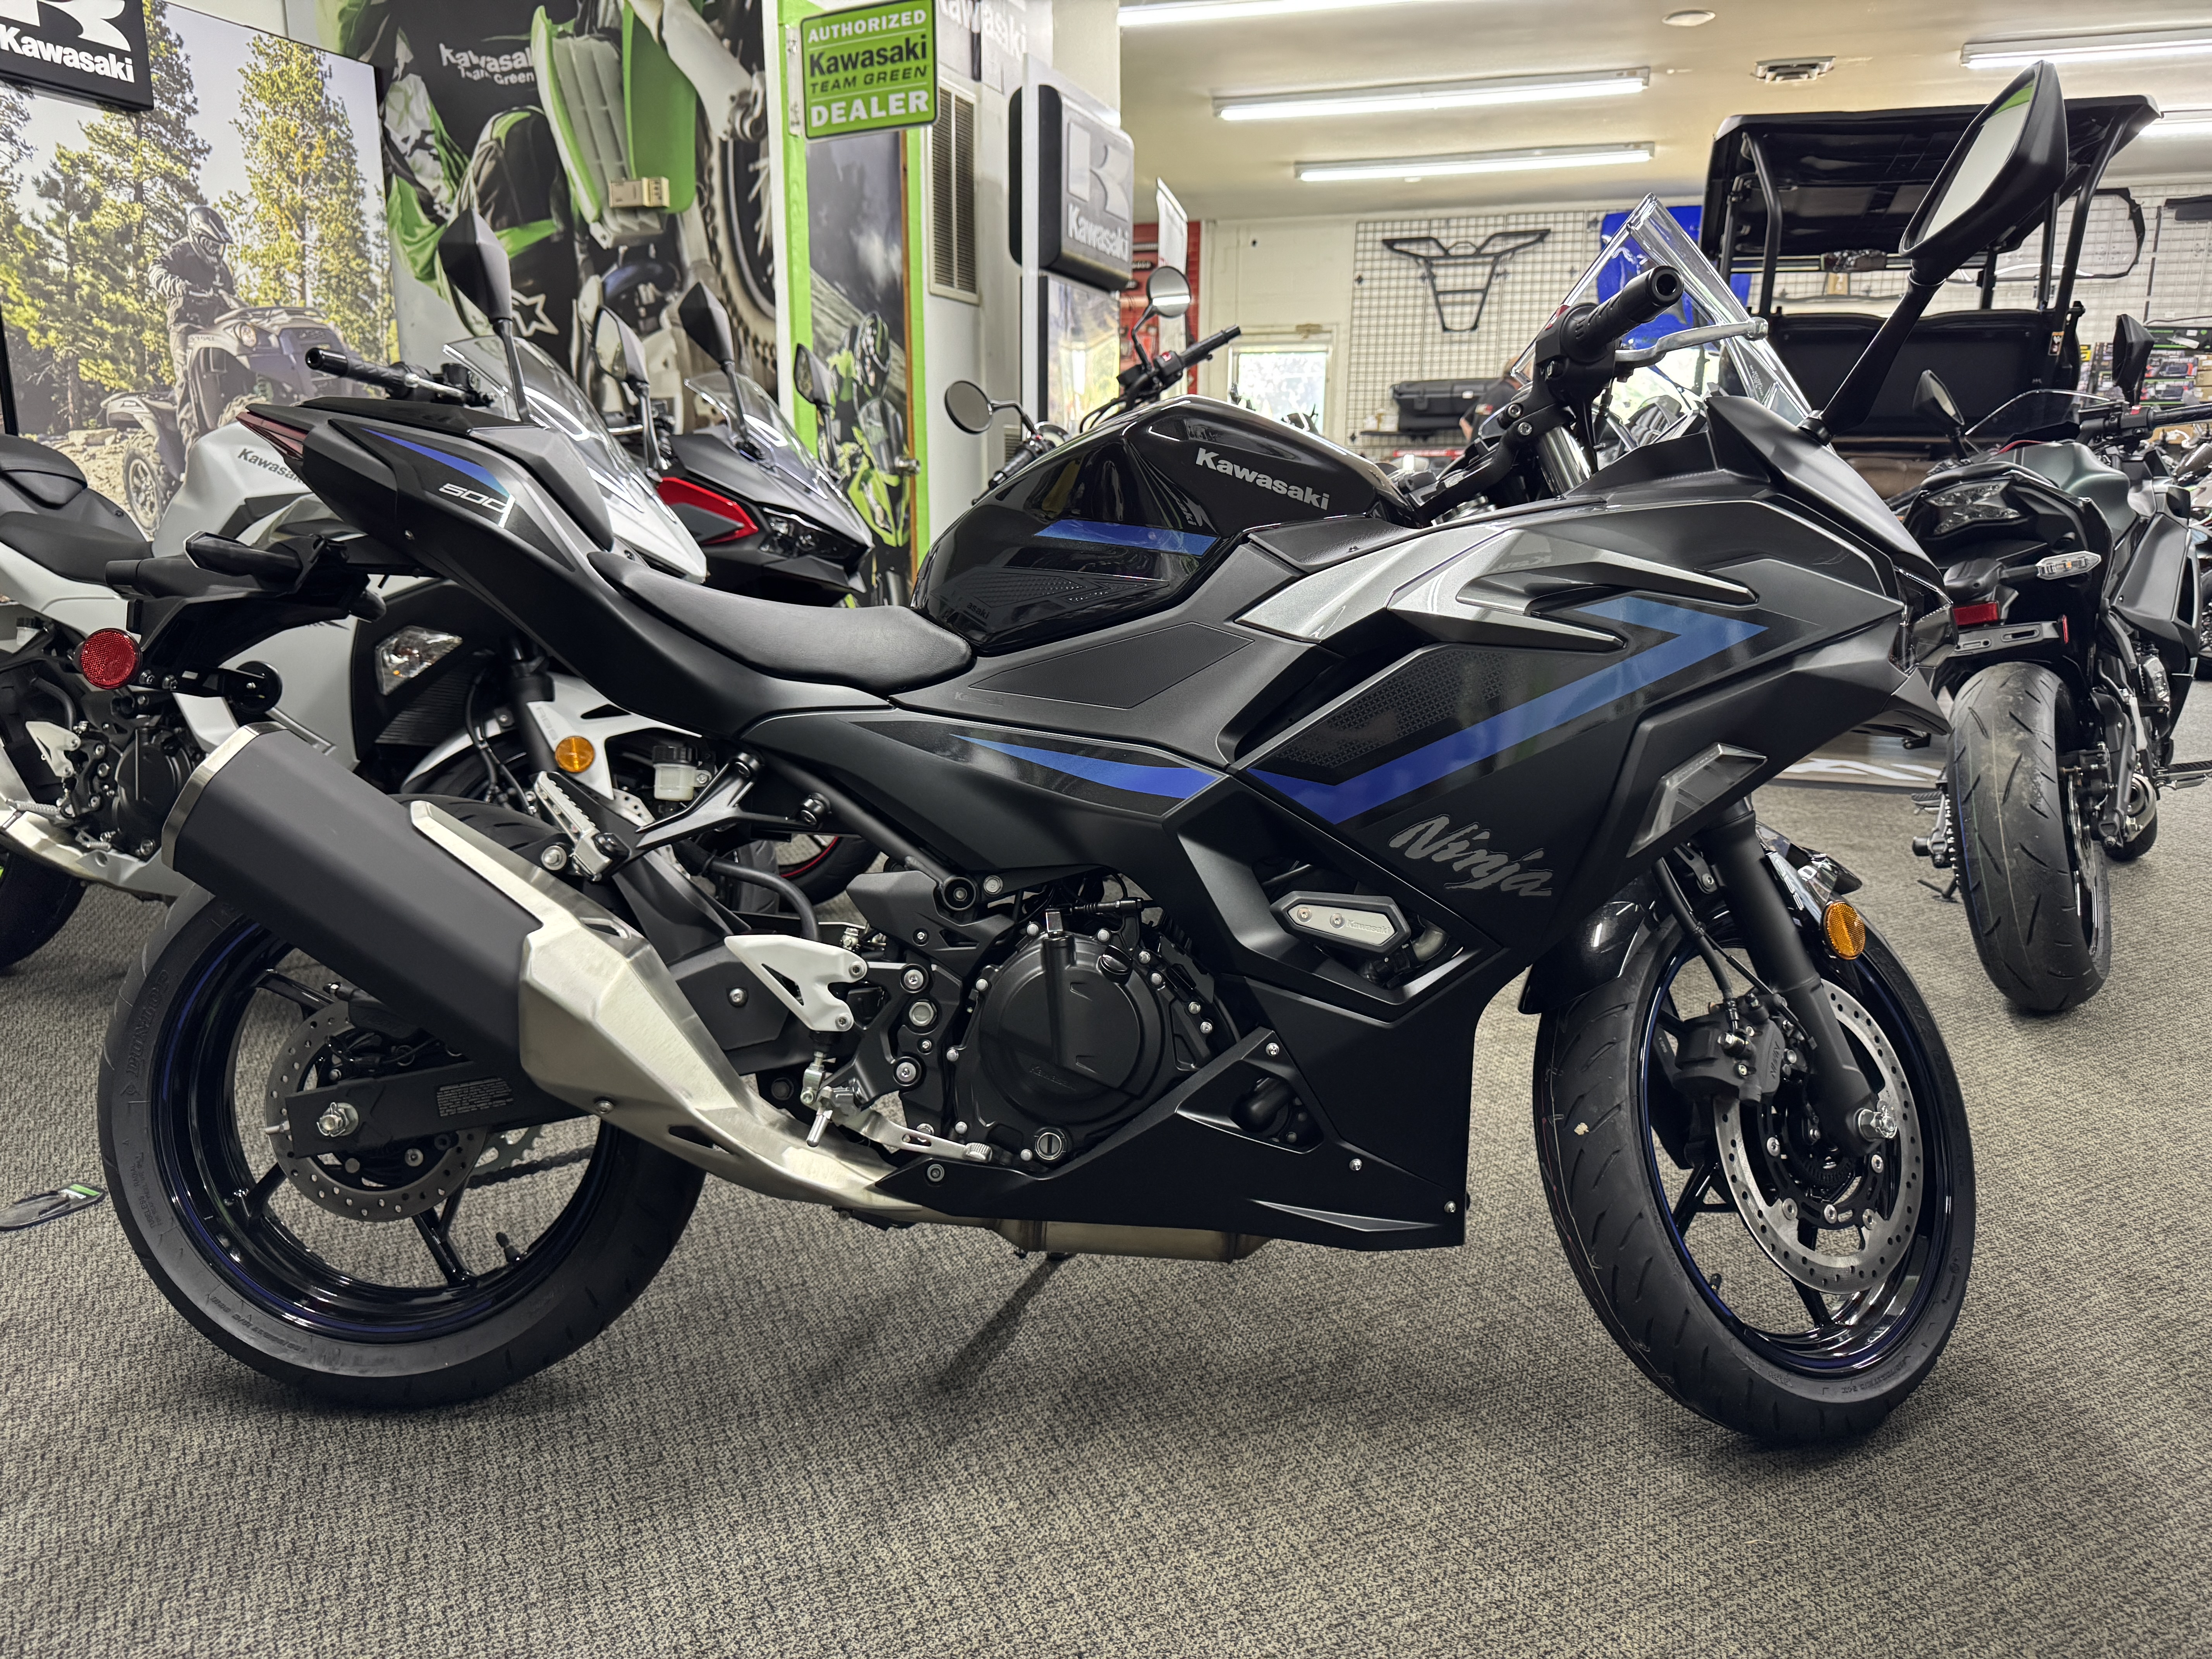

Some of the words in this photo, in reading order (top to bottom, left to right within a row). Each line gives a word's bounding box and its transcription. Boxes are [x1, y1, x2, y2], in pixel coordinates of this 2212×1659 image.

[808, 9, 927, 44] AUTHORIZED
[0, 24, 135, 83] Kawasaki
[439, 43, 534, 72] Kawasa
[809, 34, 927, 77] Kawasaki
[493, 72, 535, 86] Green
[810, 75, 857, 94] TEAM
[863, 65, 927, 86] GREEN
[811, 90, 929, 127] DEALER
[1068, 203, 1128, 263] Kawasaki
[238, 448, 303, 484] Kawasa
[1196, 447, 1330, 510] Kawasaki
[1389, 815, 1553, 896] Ninja
[1346, 919, 1390, 935] Kawasaki
